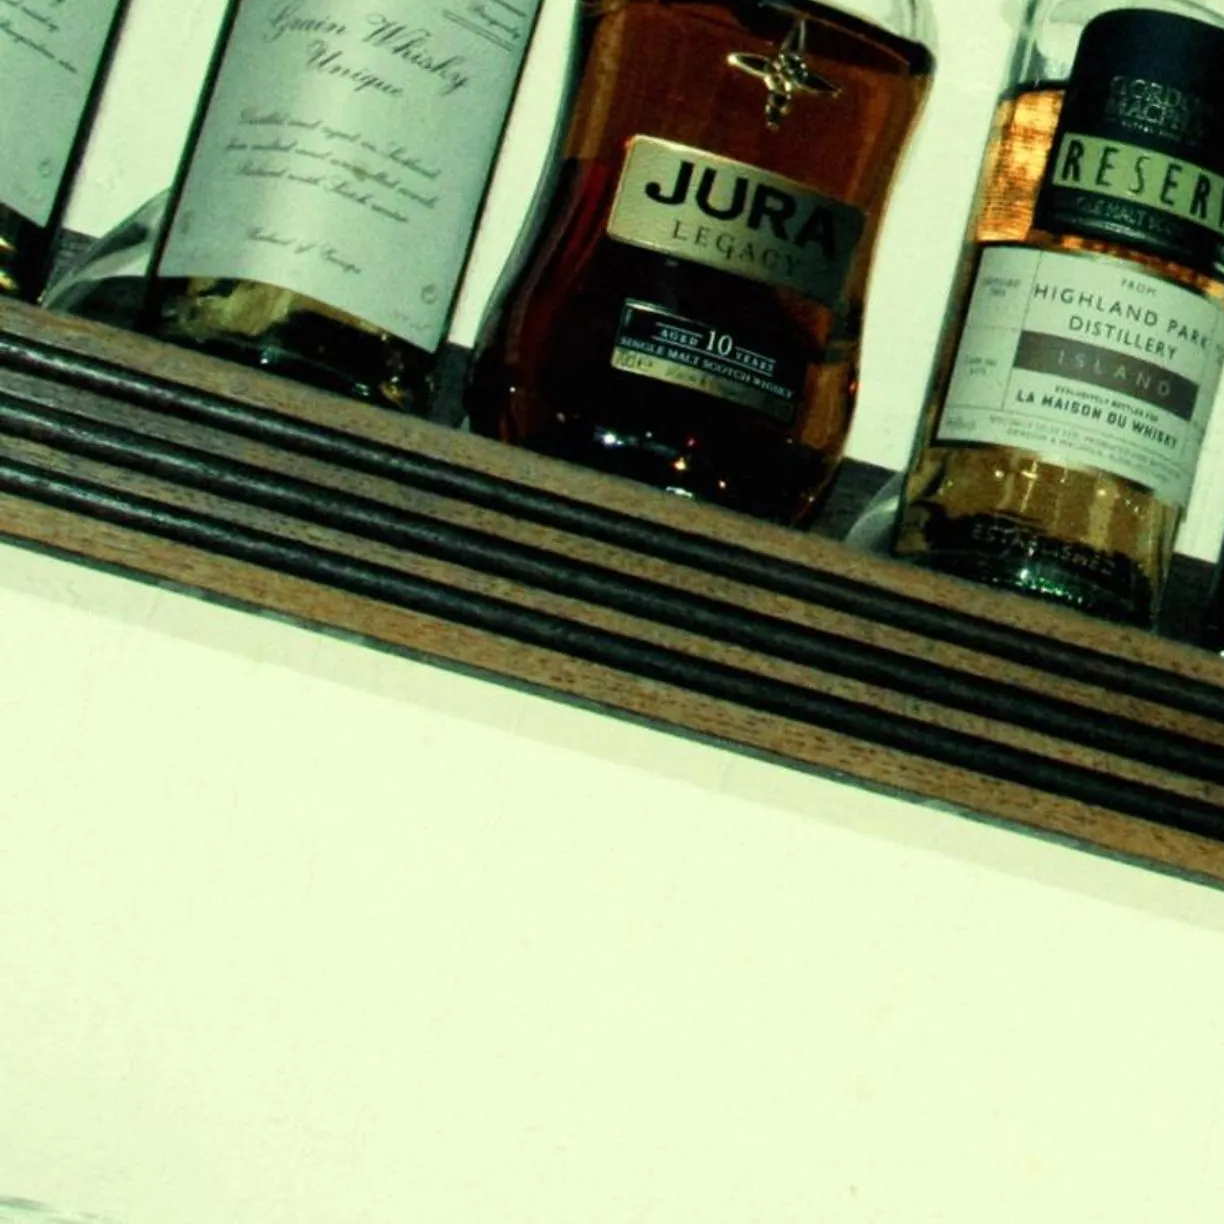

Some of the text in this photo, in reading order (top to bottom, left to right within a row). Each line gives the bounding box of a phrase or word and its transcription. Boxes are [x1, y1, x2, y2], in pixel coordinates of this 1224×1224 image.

[262, 0, 347, 43] Grain
[361, 13, 469, 96] Whisky
[304, 40, 404, 98] Unique
[645, 160, 838, 260] JURA
[672, 220, 800, 275] LEGACY
[1121, 277, 1158, 297] FROM
[1034, 282, 1159, 327] HIGHLAND
[1166, 317, 1211, 350] PARK
[1069, 315, 1178, 360] DISTILLERY
[620, 336, 664, 356] SINGLE
[667, 346, 700, 366] MALT
[702, 357, 751, 382] SCOTCH
[660, 329, 775, 375] AGED 10 YEARS
[1056, 349, 1171, 397] ISLAND
[1016, 389, 1178, 450] LA MAISON DU WHISKY
